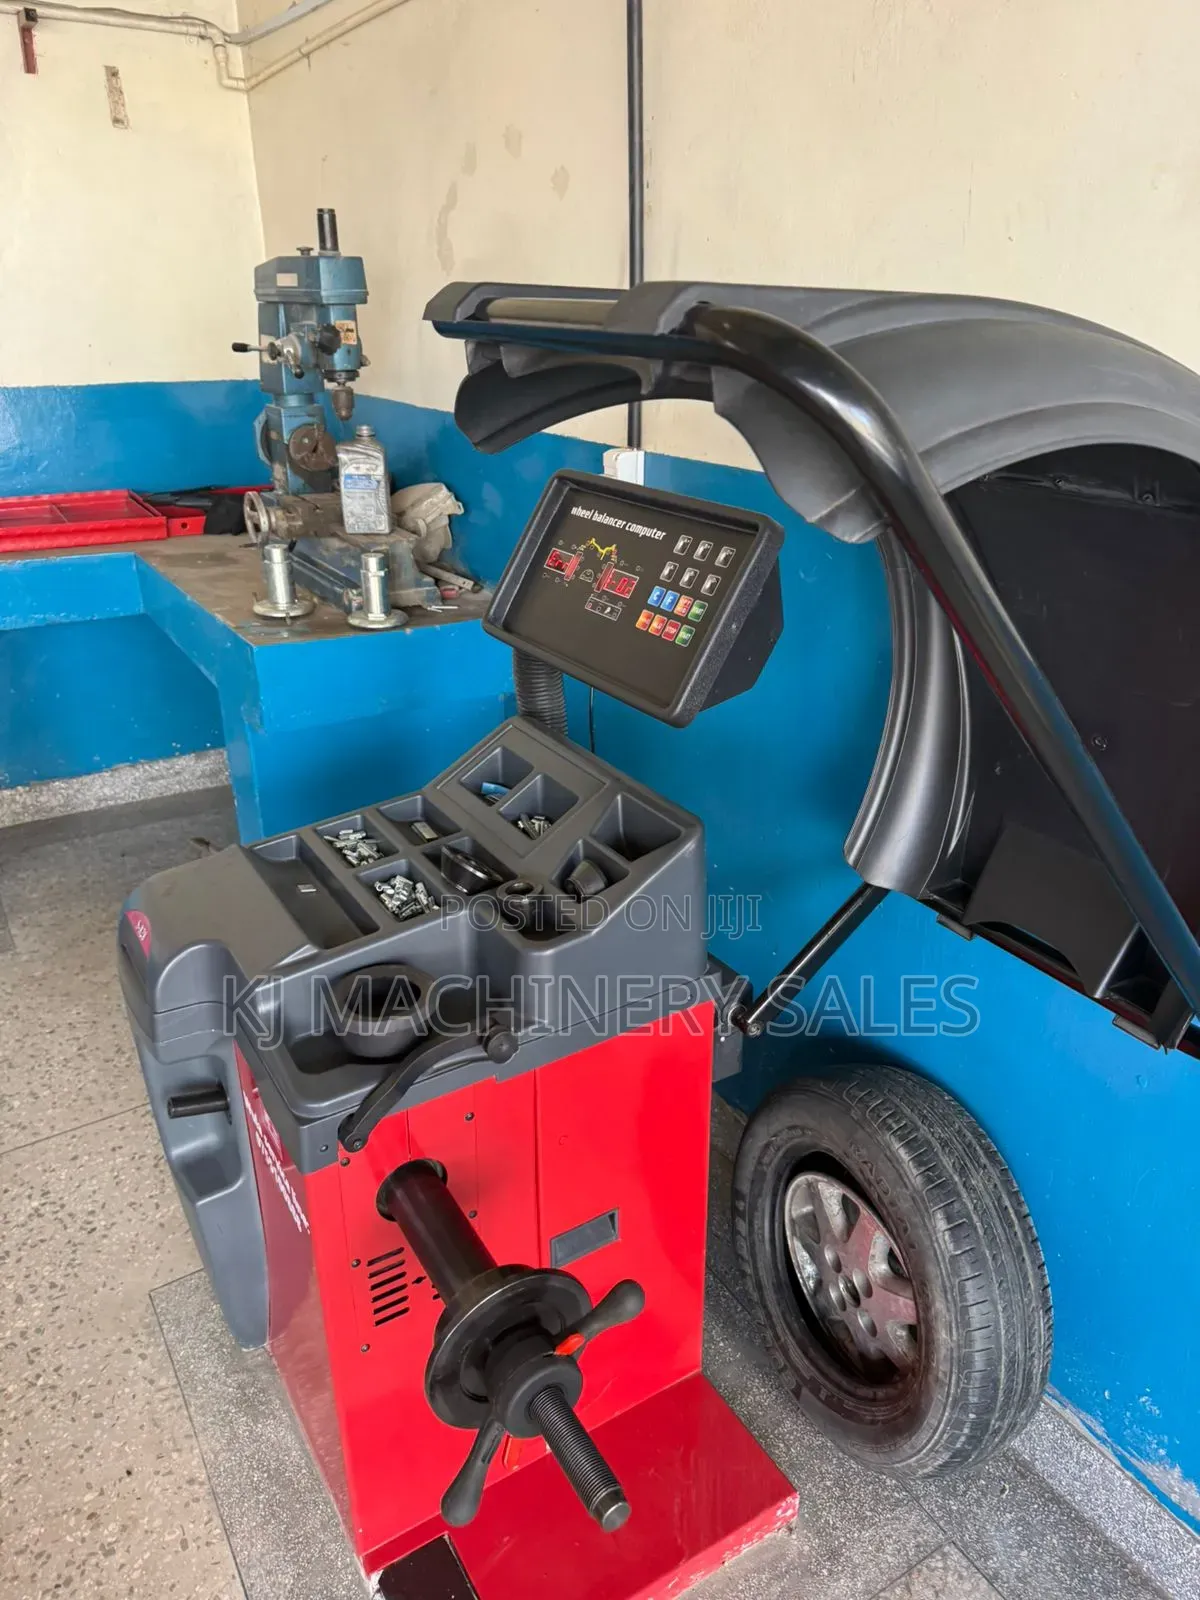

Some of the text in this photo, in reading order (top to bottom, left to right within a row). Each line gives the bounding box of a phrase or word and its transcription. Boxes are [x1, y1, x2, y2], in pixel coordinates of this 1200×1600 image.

[571, 506, 666, 541] wheel balancer computer
